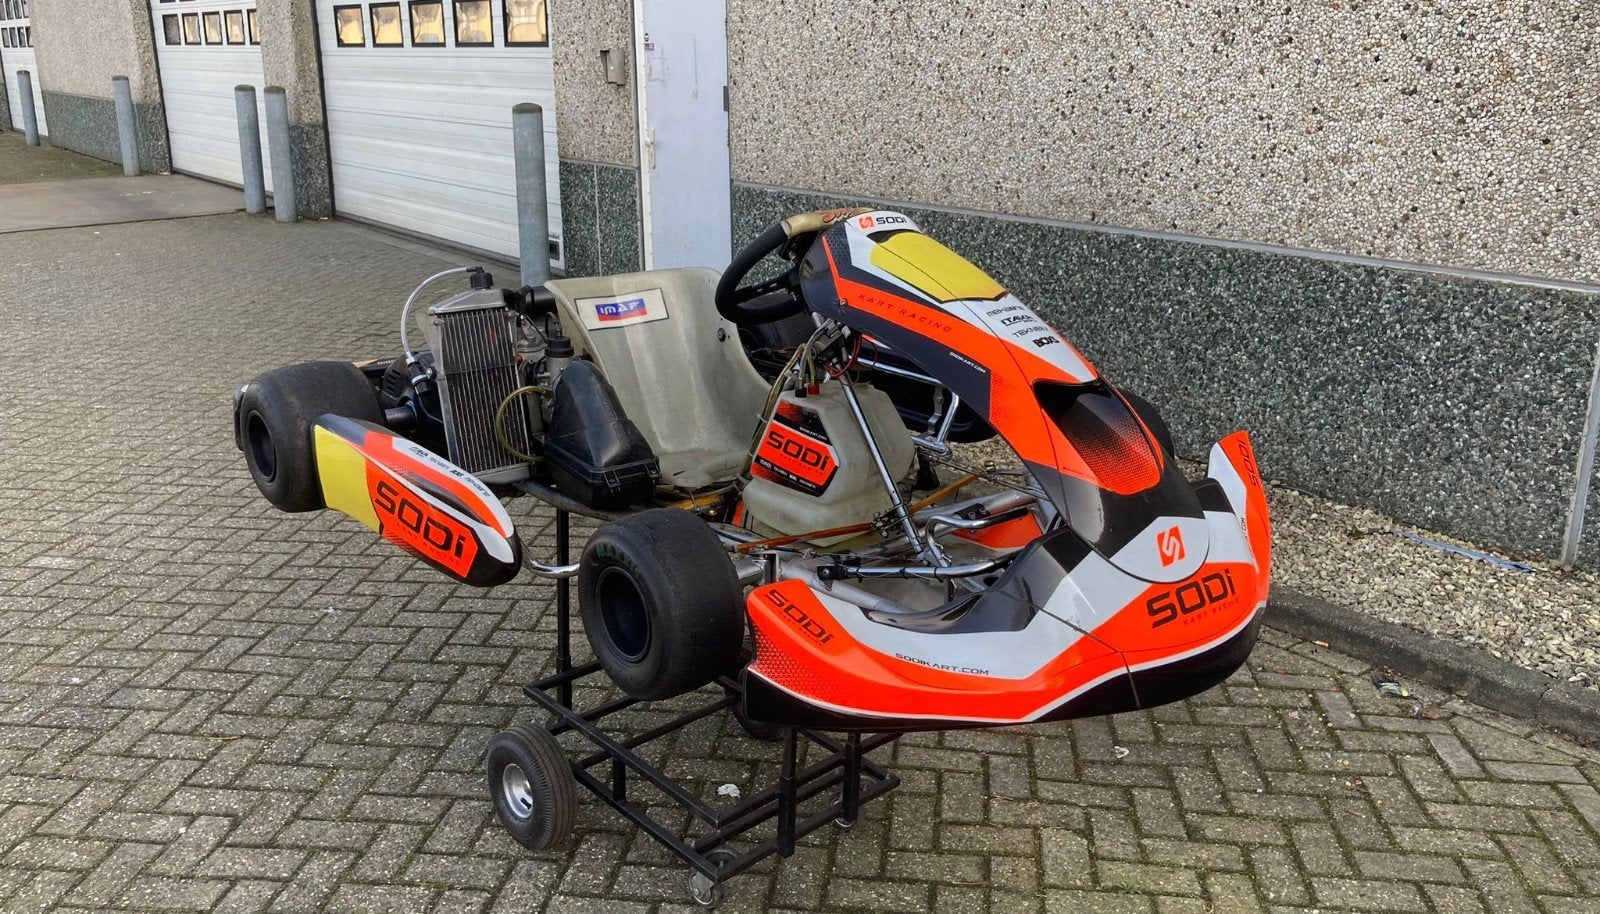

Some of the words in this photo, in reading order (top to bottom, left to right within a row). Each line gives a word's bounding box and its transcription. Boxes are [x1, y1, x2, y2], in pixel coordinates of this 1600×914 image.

[857, 294, 894, 310] KART
[899, 308, 952, 333] RACING
[895, 652, 990, 676] SODIKART.COM
